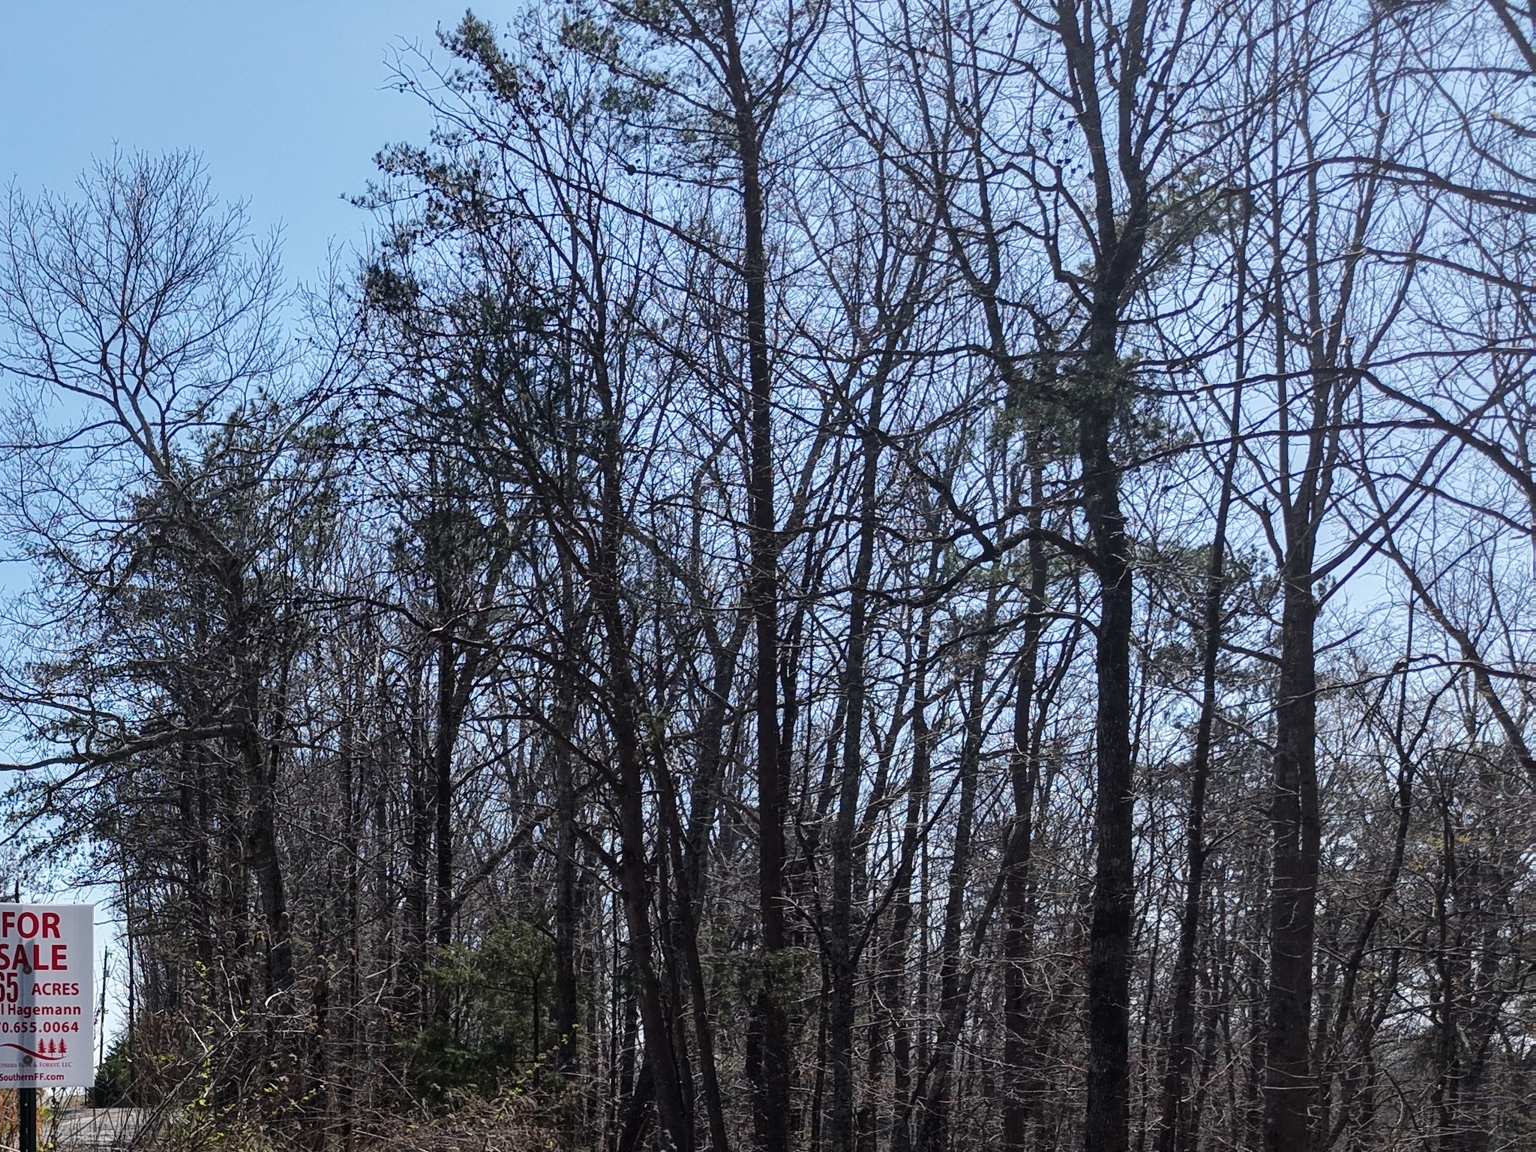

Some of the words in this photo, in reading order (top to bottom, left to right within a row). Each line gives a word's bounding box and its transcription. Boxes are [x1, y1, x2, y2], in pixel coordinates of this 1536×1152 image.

[1, 911, 61, 939] FOR
[31, 983, 79, 996] ACRES
[7, 1004, 81, 1018] Hagemann
[0, 1073, 65, 1082] SouthernFF.com
